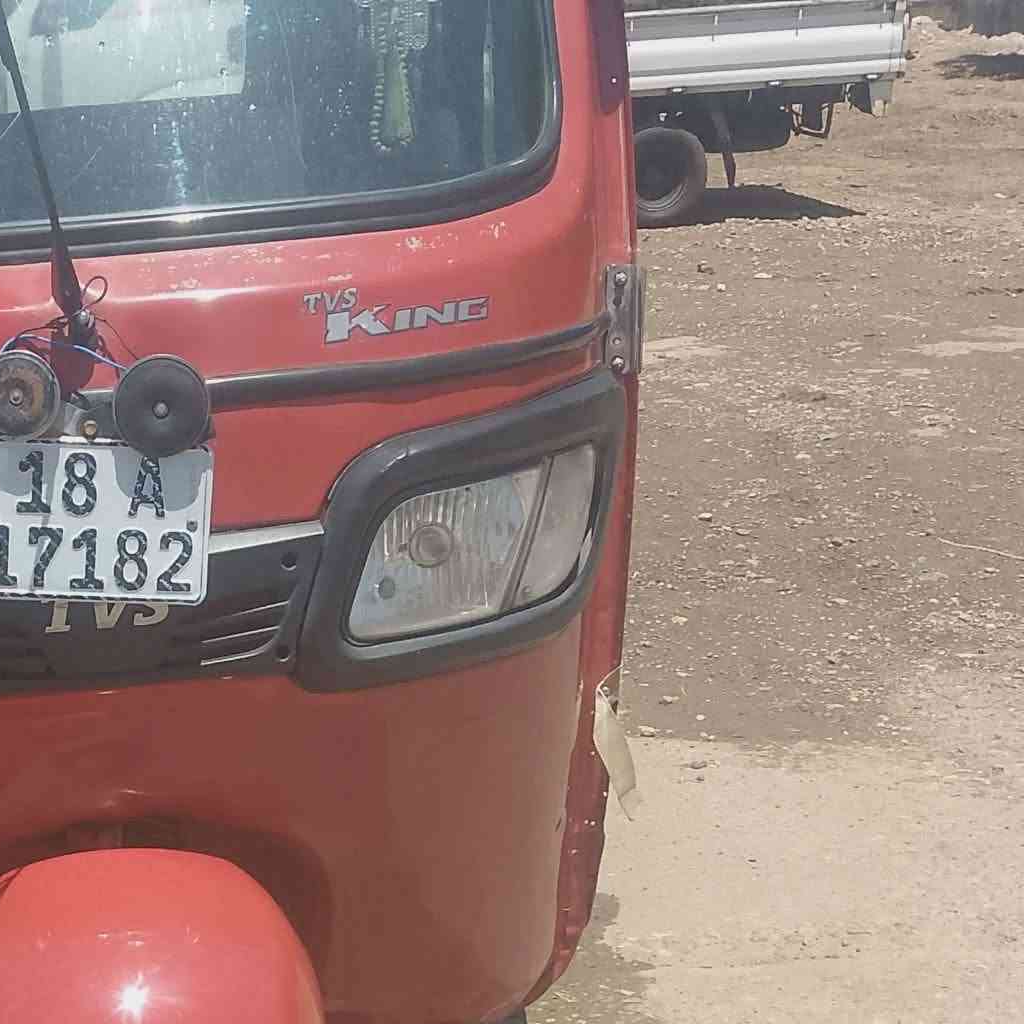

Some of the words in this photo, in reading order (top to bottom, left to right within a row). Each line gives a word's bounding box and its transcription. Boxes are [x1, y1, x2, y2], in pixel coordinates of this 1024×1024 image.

[304, 288, 357, 314] TVS
[324, 296, 489, 343] KING
[16, 451, 97, 516] 18
[128, 455, 166, 518] A
